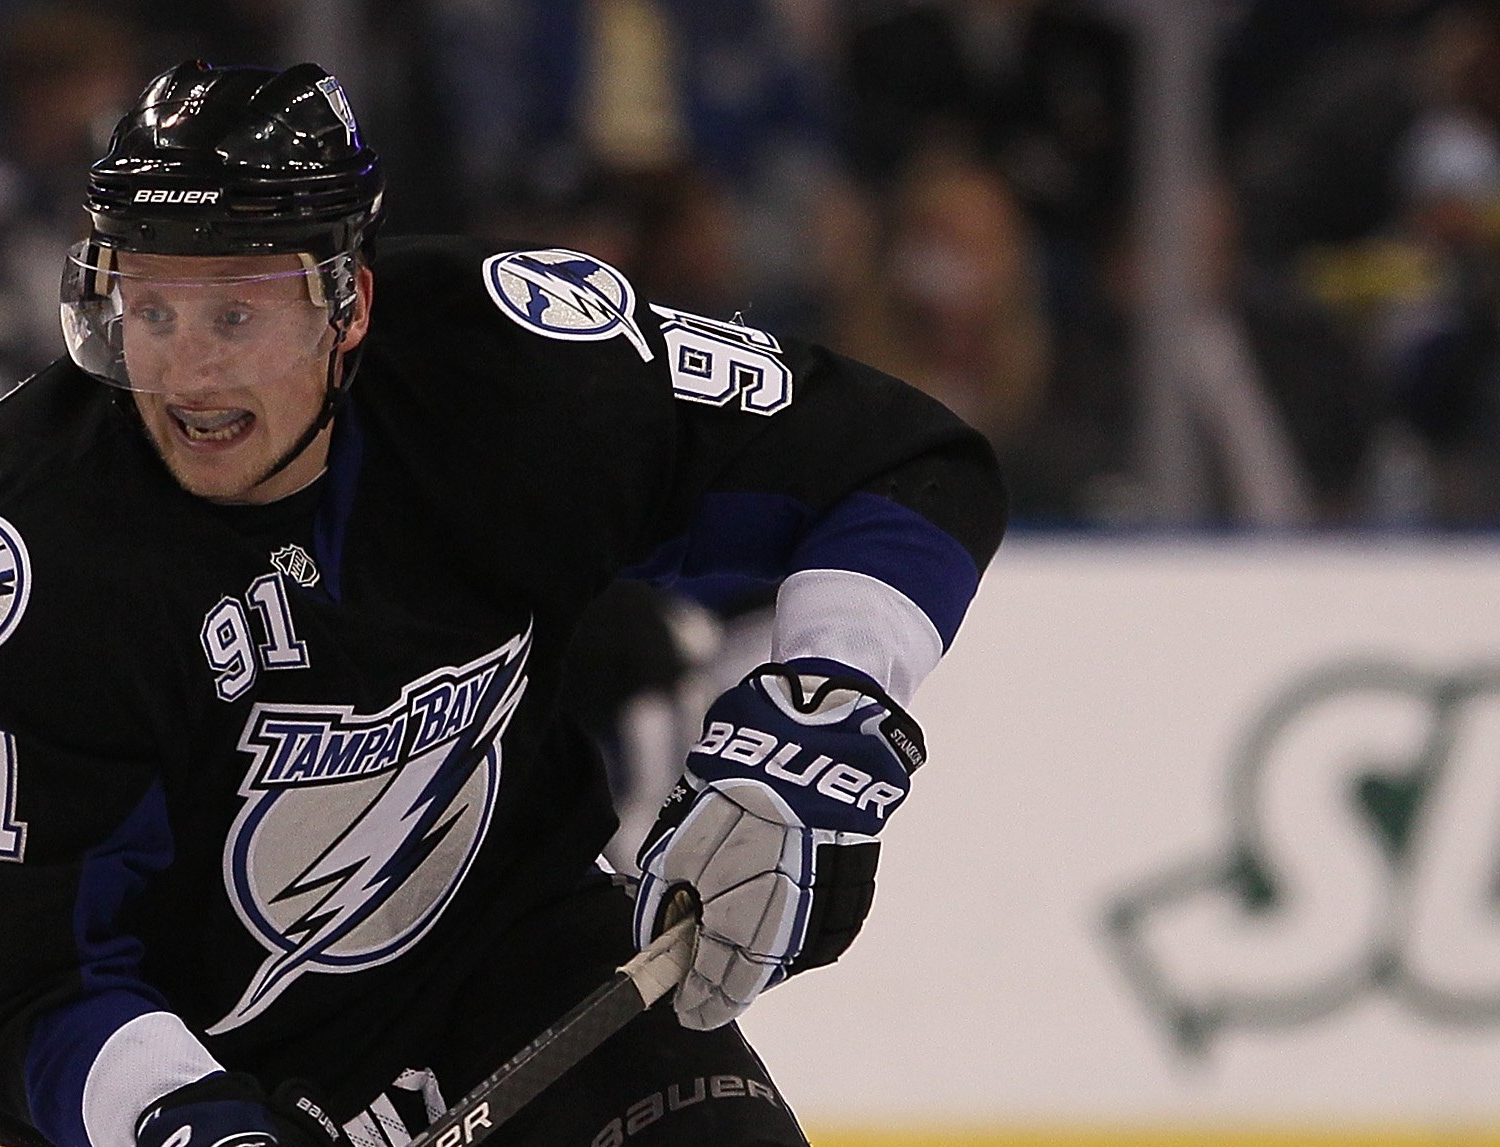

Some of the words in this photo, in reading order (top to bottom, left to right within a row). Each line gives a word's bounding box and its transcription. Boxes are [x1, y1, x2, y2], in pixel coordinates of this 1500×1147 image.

[133, 189, 219, 204] BAUER
[200, 572, 311, 702] 91
[260, 713, 407, 784] TAMPA
[408, 668, 498, 758] BAY
[691, 721, 905, 819] BAUER
[296, 1097, 340, 1142] BAUER
